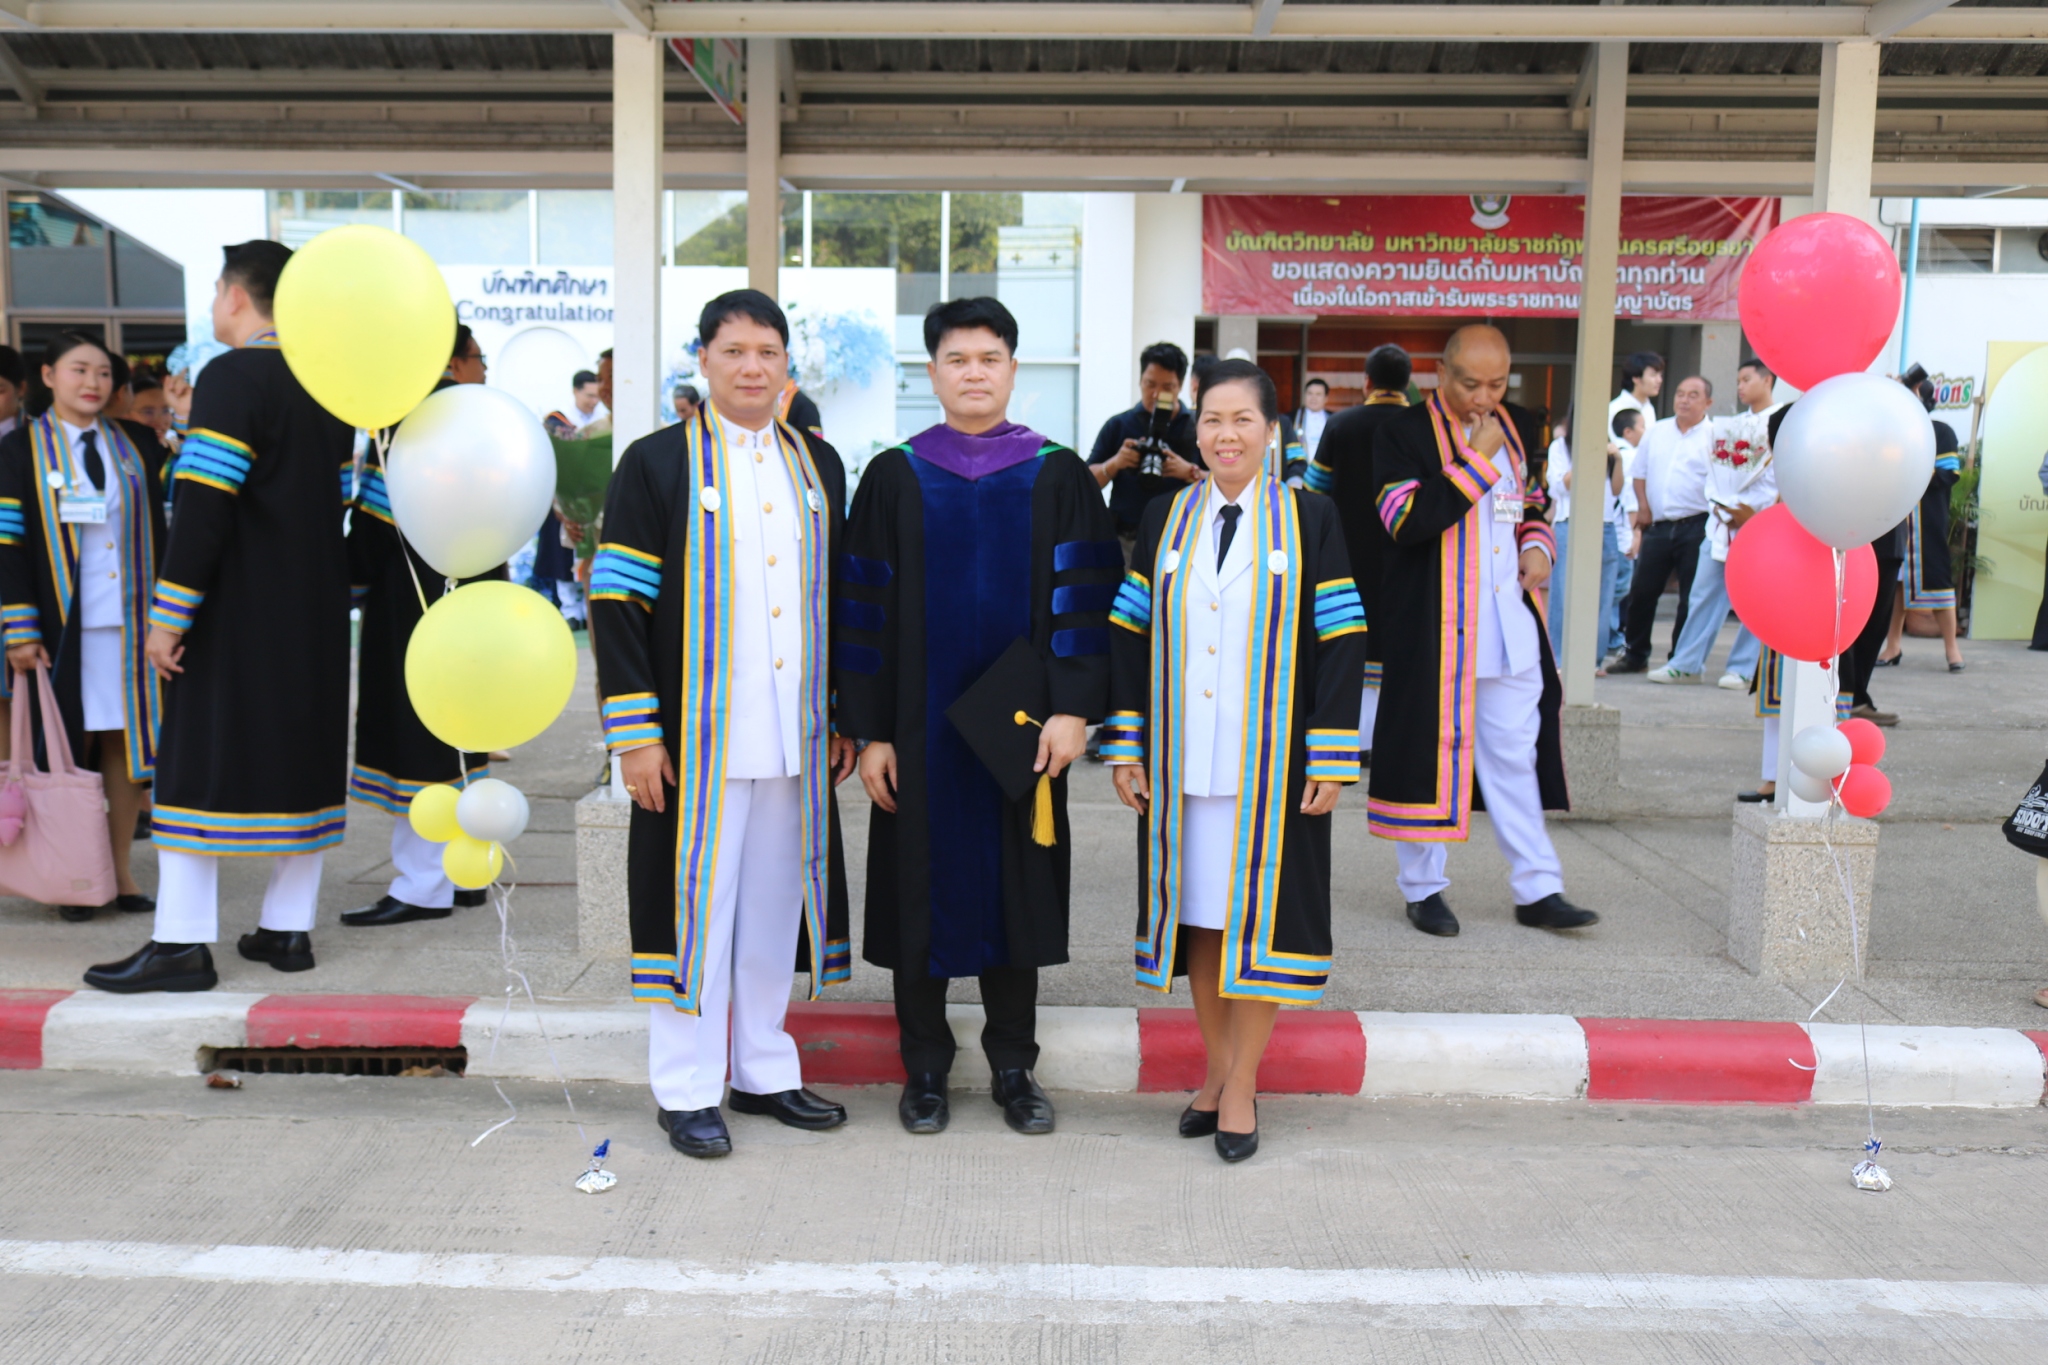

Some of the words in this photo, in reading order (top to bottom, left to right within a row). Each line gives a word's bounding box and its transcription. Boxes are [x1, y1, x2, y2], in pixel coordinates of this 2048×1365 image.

[1225, 230, 1374, 252] บัณฑิตวิทยาลัย
[1385, 231, 1754, 264] มหาวิทยาลัยราชภัฏนครศรีอยุธยา
[482, 270, 607, 296] บัณฑิตศึกษา
[1271, 257, 1705, 293] ขอแสดงความยินดีกับมหาบัณตทุกท่าน
[1932, 376, 1972, 405] ions
[2019, 493, 2048, 512] บัณ
